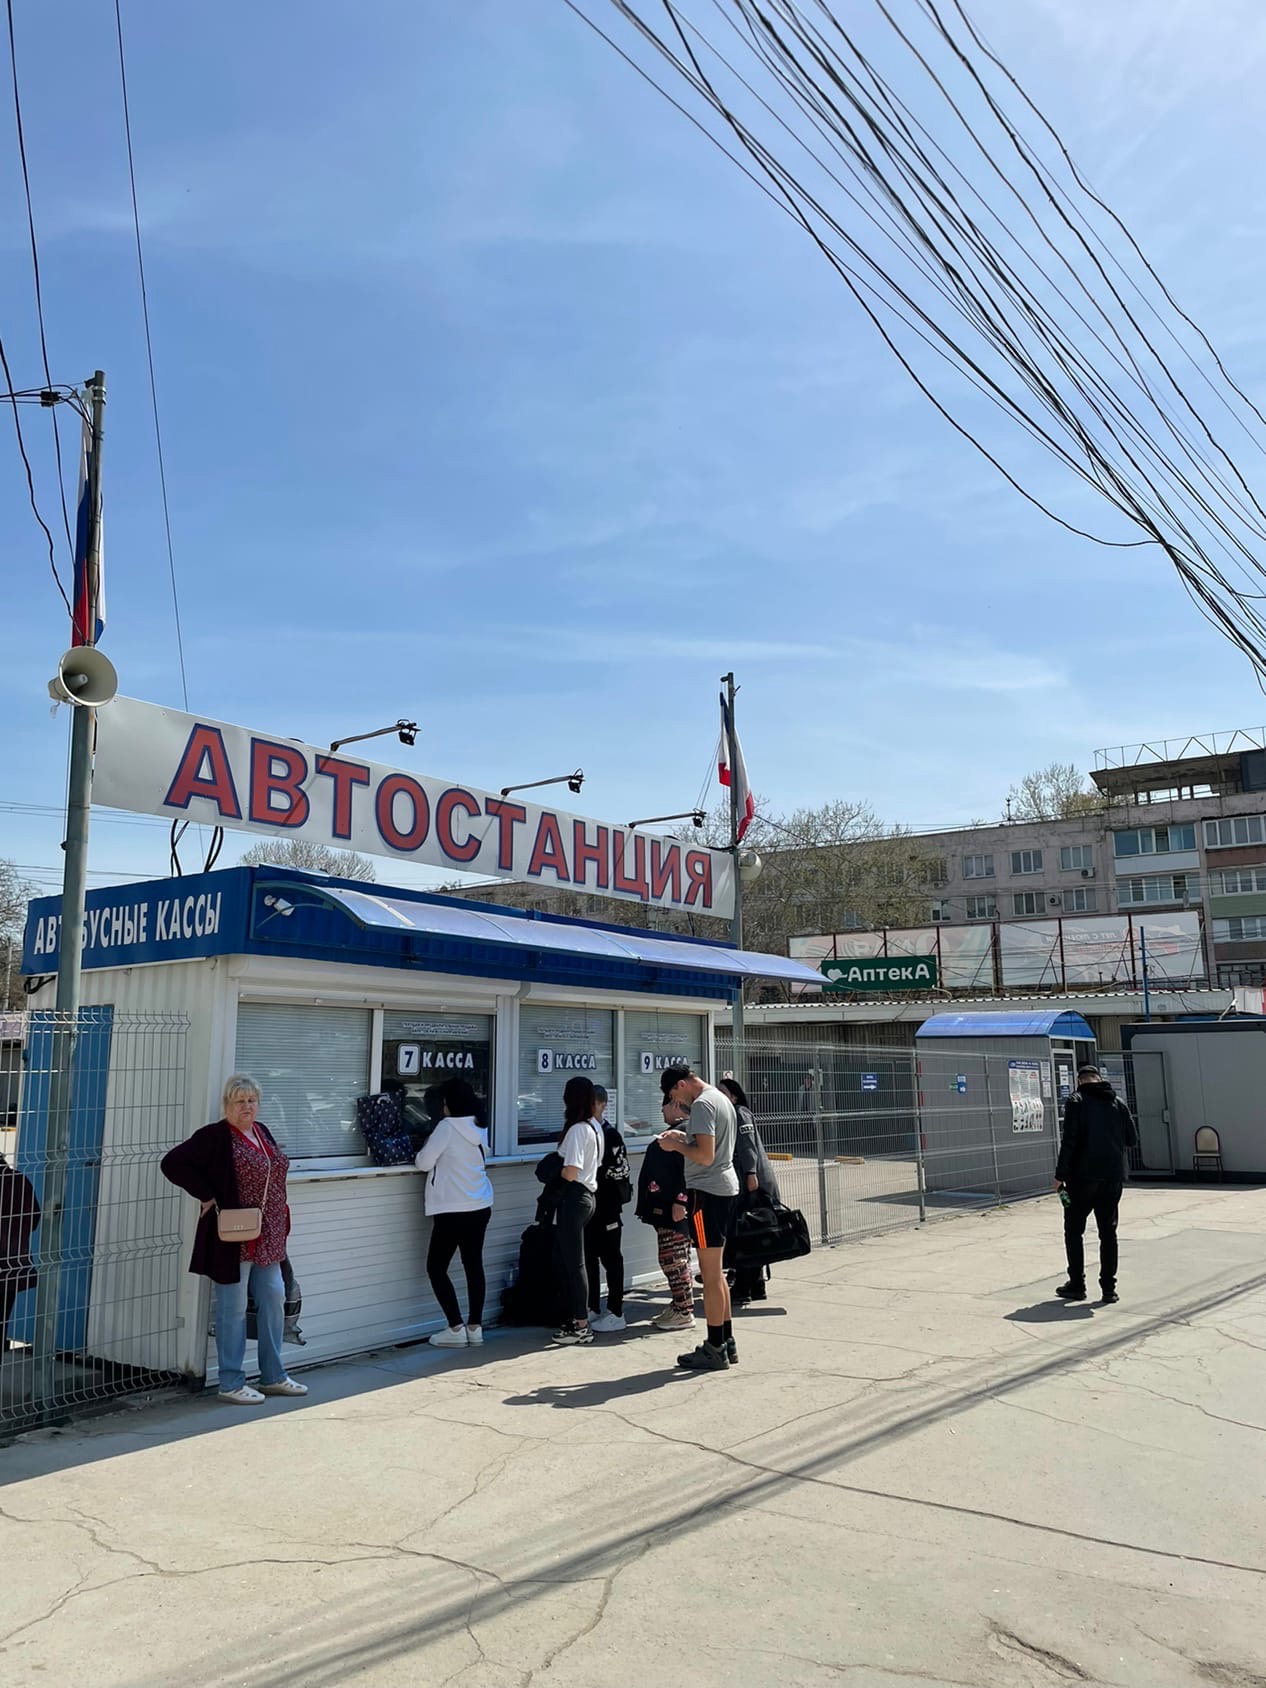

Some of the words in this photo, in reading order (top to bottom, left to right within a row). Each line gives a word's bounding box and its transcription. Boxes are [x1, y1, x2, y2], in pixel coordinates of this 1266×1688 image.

[164, 722, 713, 909] АВТОСТАНЦИЯ
[155, 892, 222, 941] КАССЫ
[404, 1050, 414, 1068] 7
[422, 1051, 474, 1069] КАССА
[541, 1056, 549, 1069] 8
[555, 1054, 597, 1069] КАССА
[644, 1055, 651, 1070] 9
